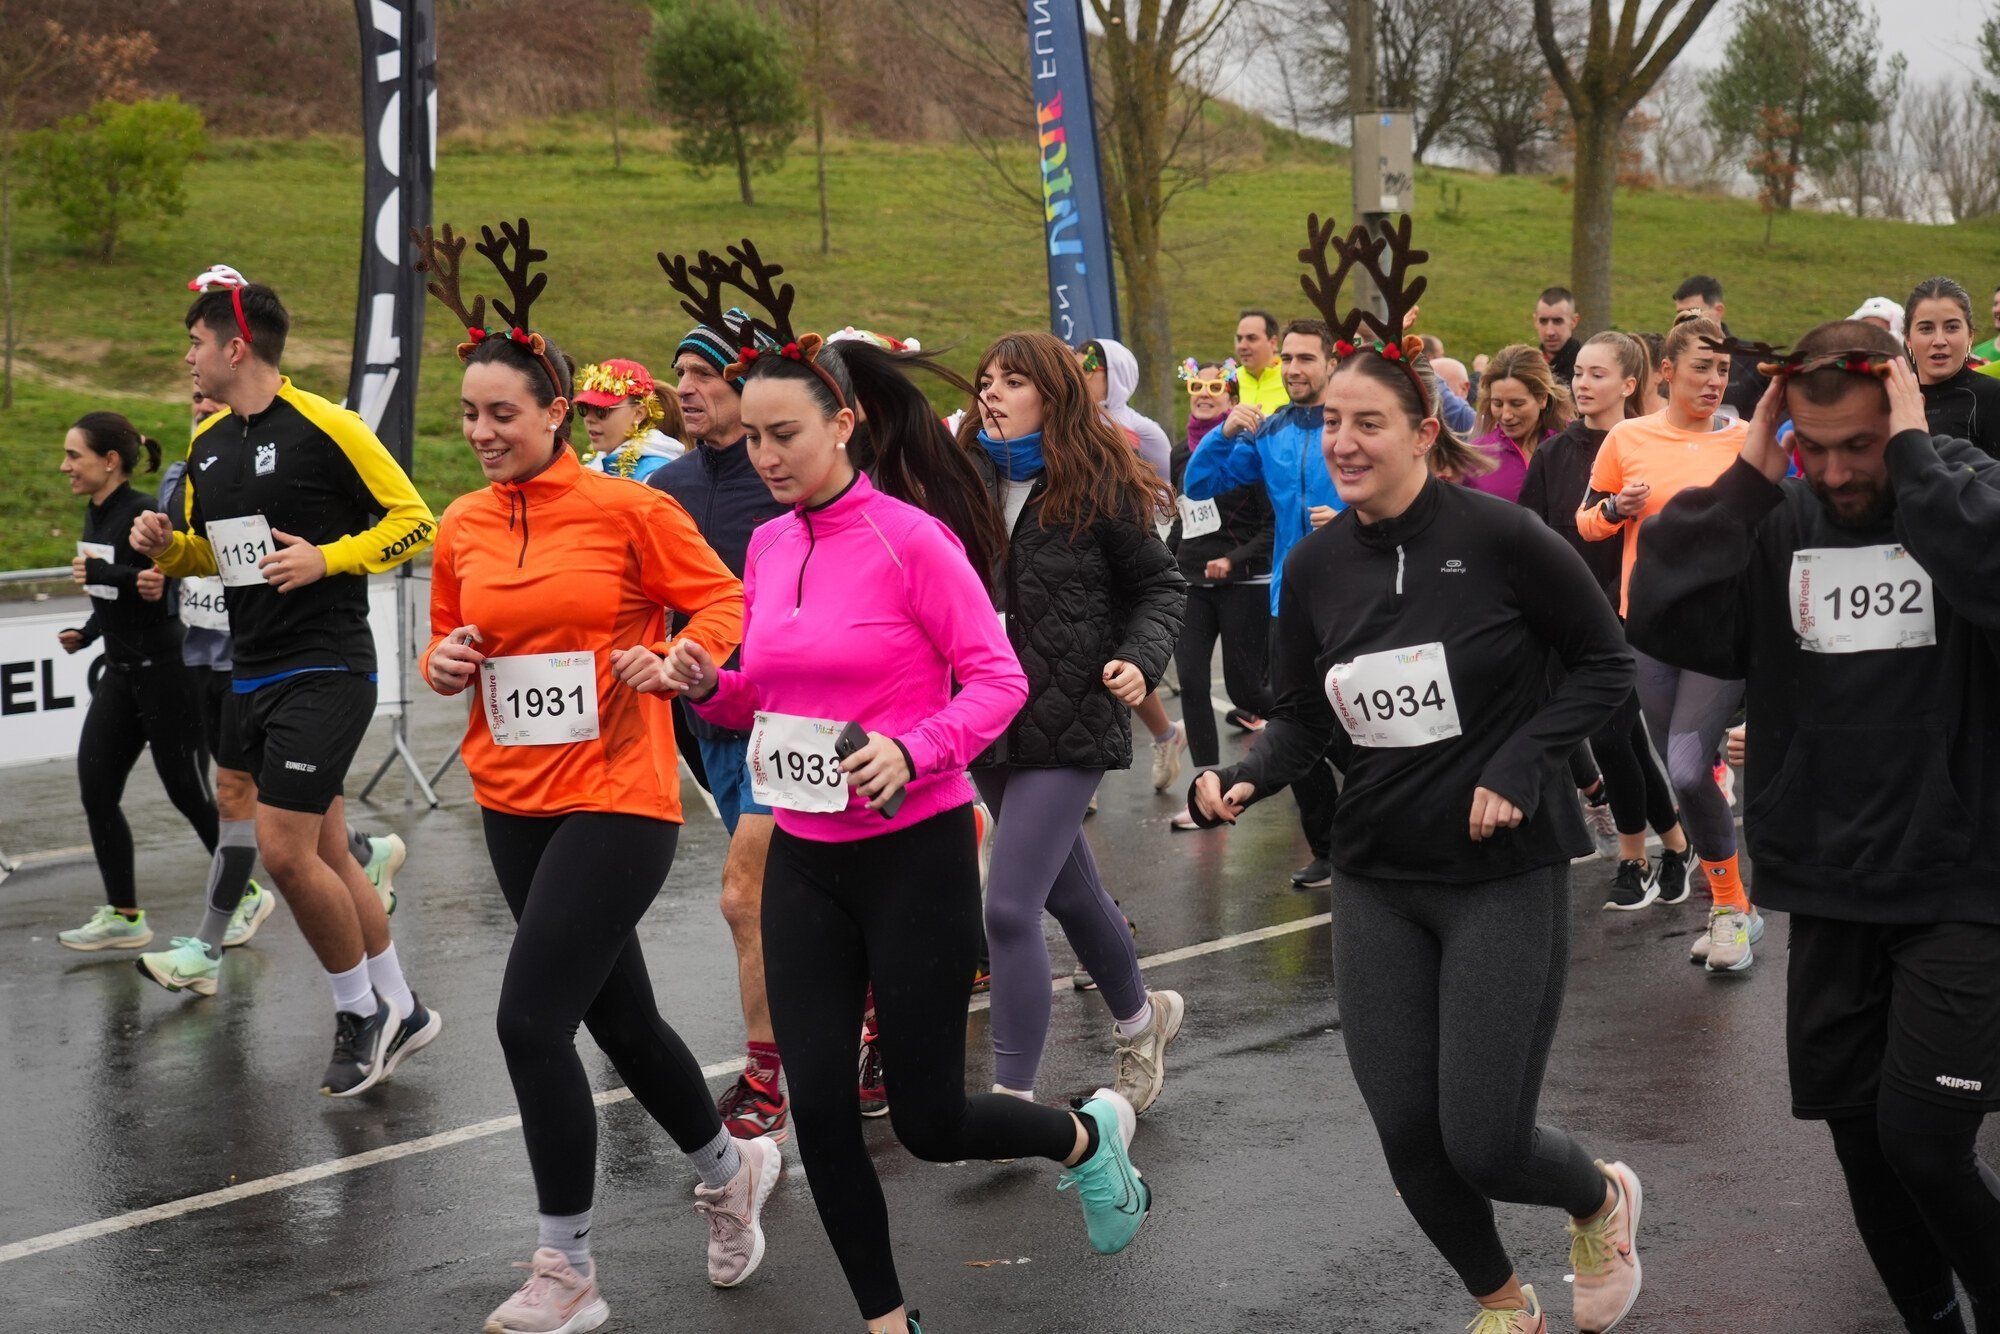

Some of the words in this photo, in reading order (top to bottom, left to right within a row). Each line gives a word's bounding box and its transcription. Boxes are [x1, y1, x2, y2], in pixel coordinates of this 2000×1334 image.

[222, 539, 268, 567] 1131
[1824, 579, 1924, 621] 1932
[506, 685, 584, 719] 1931
[1353, 679, 1446, 722] 1934
[768, 749, 842, 788] 1933
